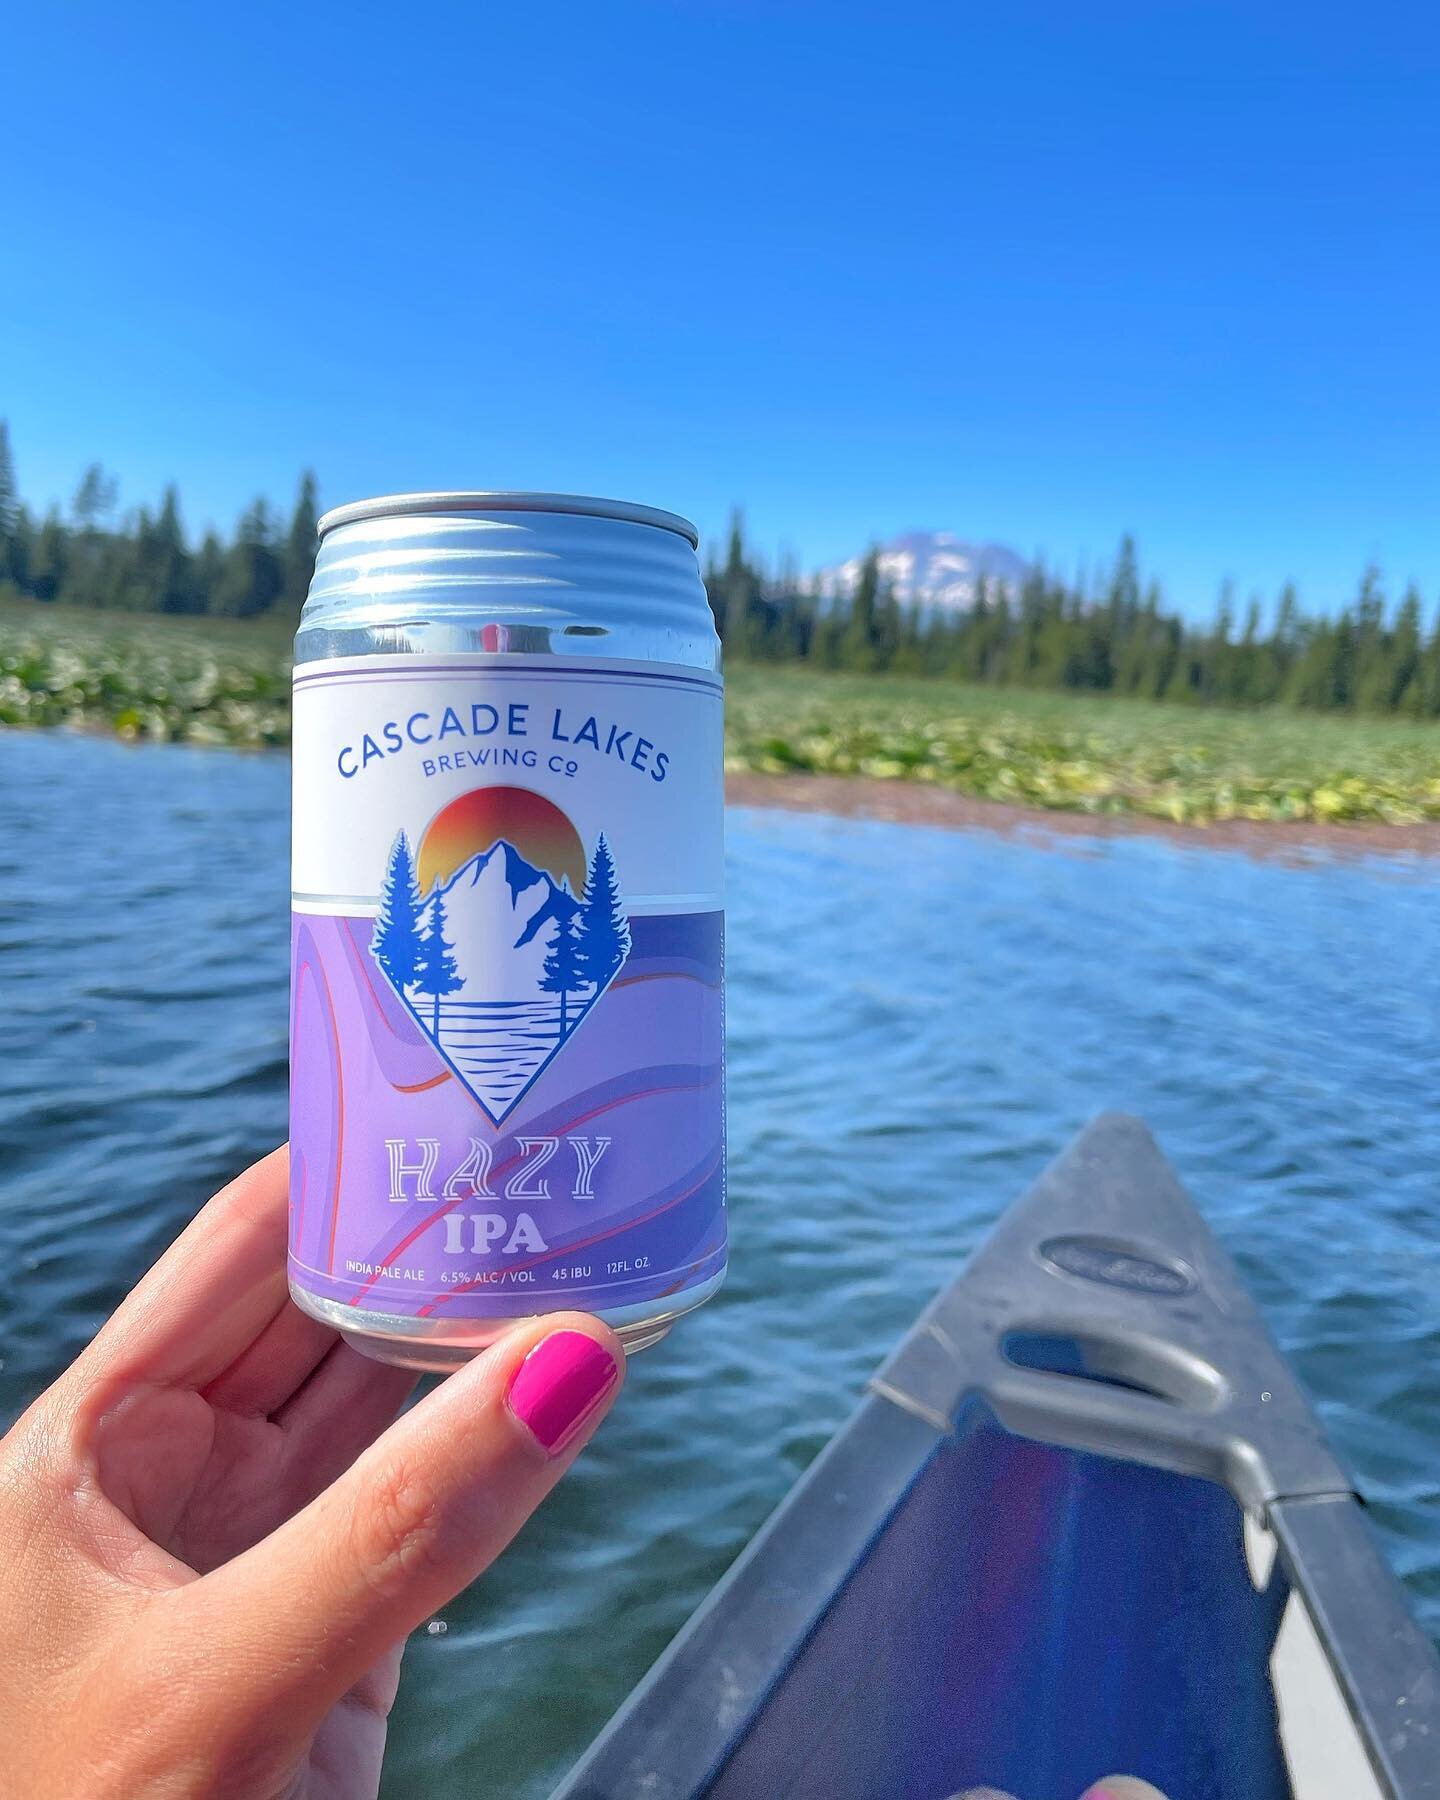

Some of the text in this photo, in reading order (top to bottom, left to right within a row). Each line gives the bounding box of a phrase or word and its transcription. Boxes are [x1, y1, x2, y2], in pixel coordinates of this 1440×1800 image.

[338, 703, 670, 782] CASCADE LAKES
[423, 748, 537, 777] BREWING
[385, 1136, 611, 1202] HAZY
[443, 1212, 549, 1254] IPA
[346, 1260, 425, 1281] INDIA PALE ALE
[440, 1271, 471, 1283] 6.5%
[474, 1271, 498, 1284] ALC
[509, 1271, 536, 1283] VOL
[552, 1266, 592, 1280] 45 IBU
